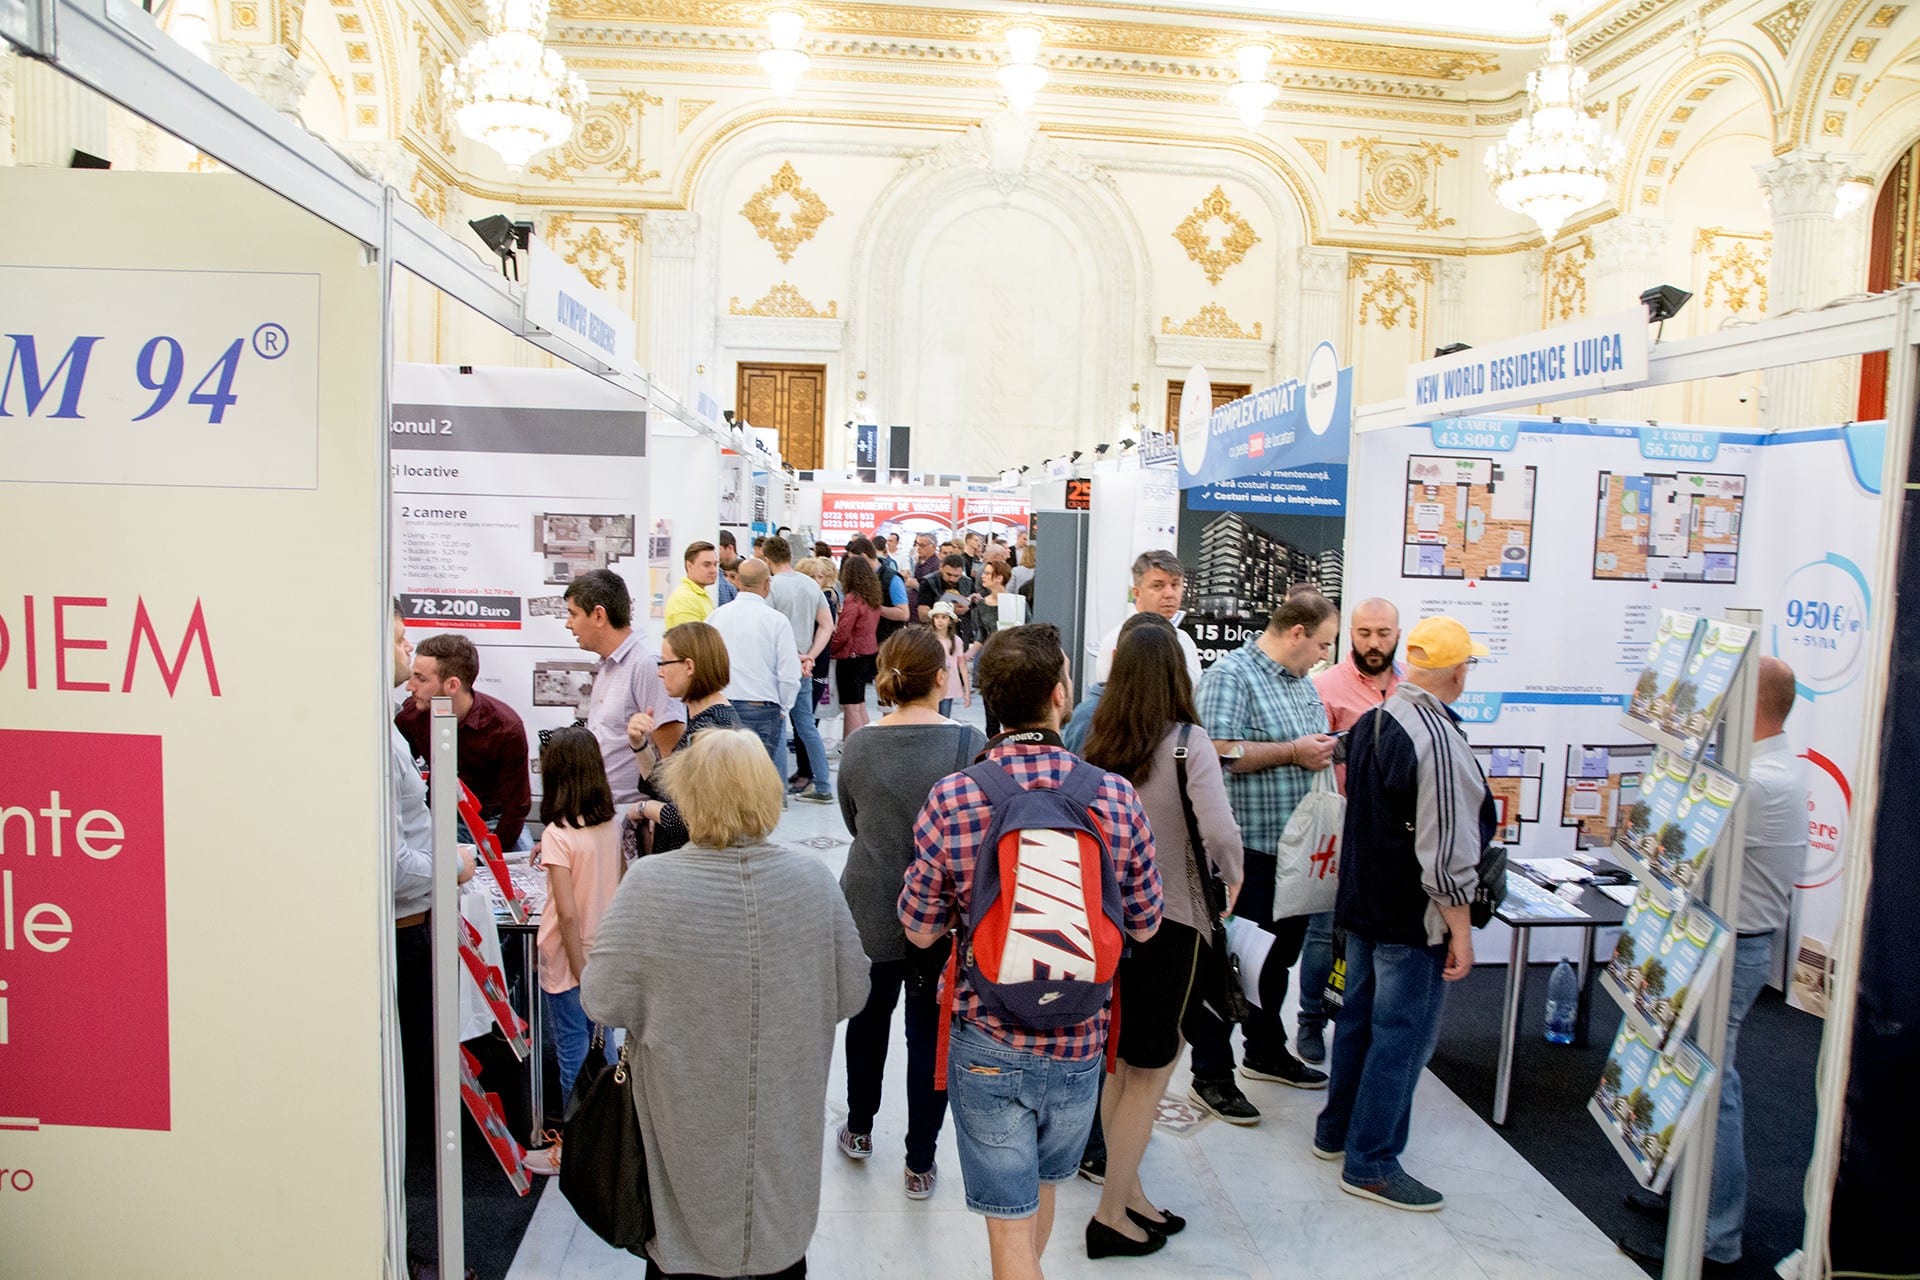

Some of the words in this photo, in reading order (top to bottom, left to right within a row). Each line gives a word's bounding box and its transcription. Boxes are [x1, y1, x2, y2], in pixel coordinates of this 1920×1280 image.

[1416, 373, 1439, 406] NEW
[1444, 363, 1485, 400] WORLD
[1490, 344, 1566, 391] RESIDENCE
[1573, 333, 1623, 376] LUICA
[1211, 399, 1255, 436] COMPLEX
[1256, 382, 1297, 422] PRIVAT
[440, 419, 453, 434] 2
[1438, 431, 1495, 448] 43.800
[1499, 434, 1511, 449] €
[403, 464, 459, 477] locative
[1237, 481, 1269, 490] costuri
[1214, 492, 1250, 502] Costuri
[1251, 494, 1273, 503] mici
[1274, 494, 1287, 504] de
[402, 506, 410, 517] 2
[414, 508, 468, 519] camere
[411, 598, 478, 617] 78.200
[480, 606, 511, 617] Euro
[1195, 623, 1219, 641] 15
[0, 594, 222, 699] IEM
[3, 870, 73, 952] le
